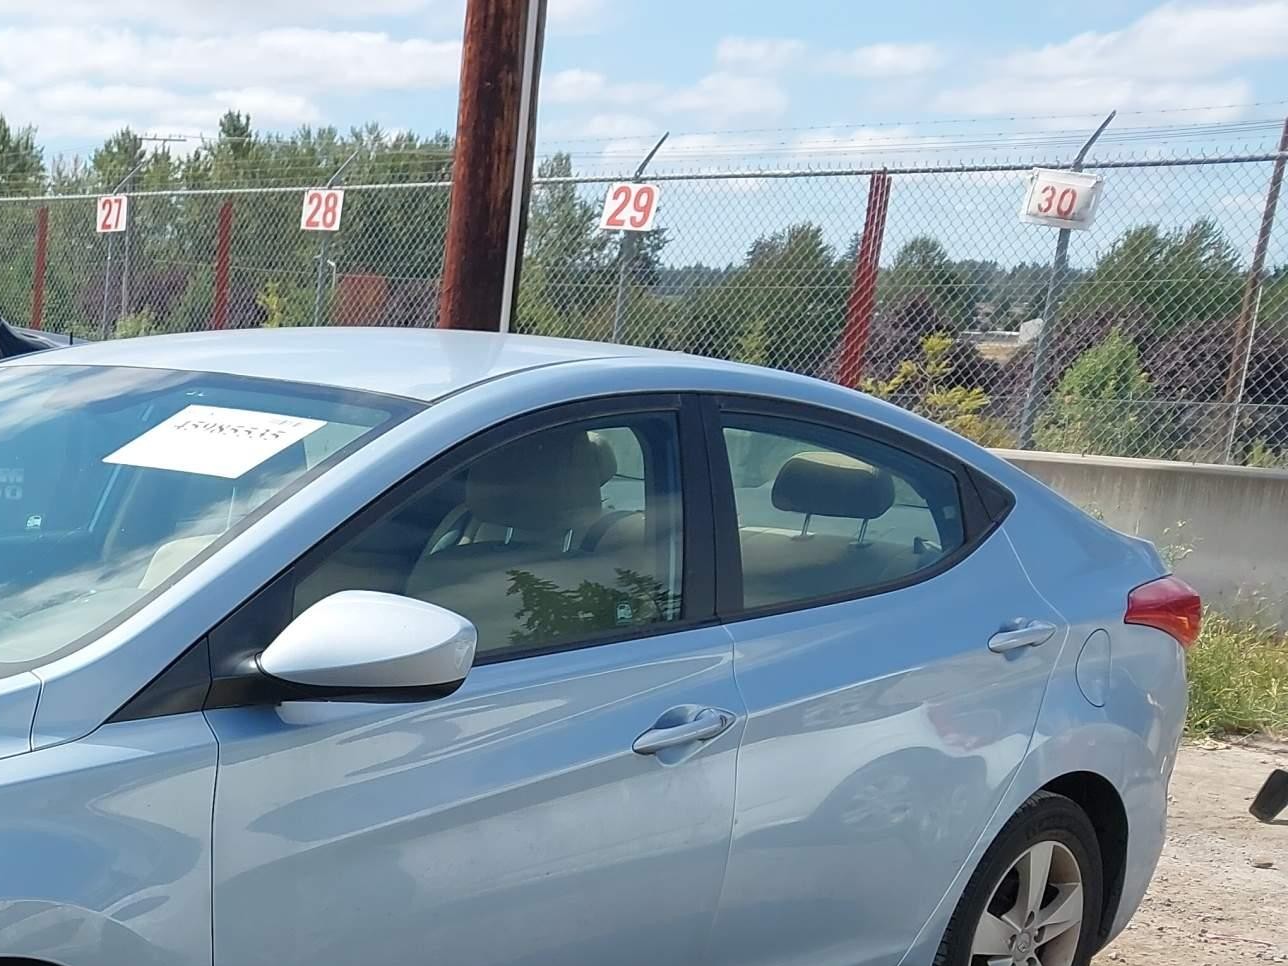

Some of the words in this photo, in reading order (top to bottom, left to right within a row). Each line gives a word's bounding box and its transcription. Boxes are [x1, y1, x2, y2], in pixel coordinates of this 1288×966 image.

[101, 198, 122, 230] 27
[305, 192, 338, 228] 28
[605, 185, 654, 228] 29
[1037, 185, 1077, 217] 30
